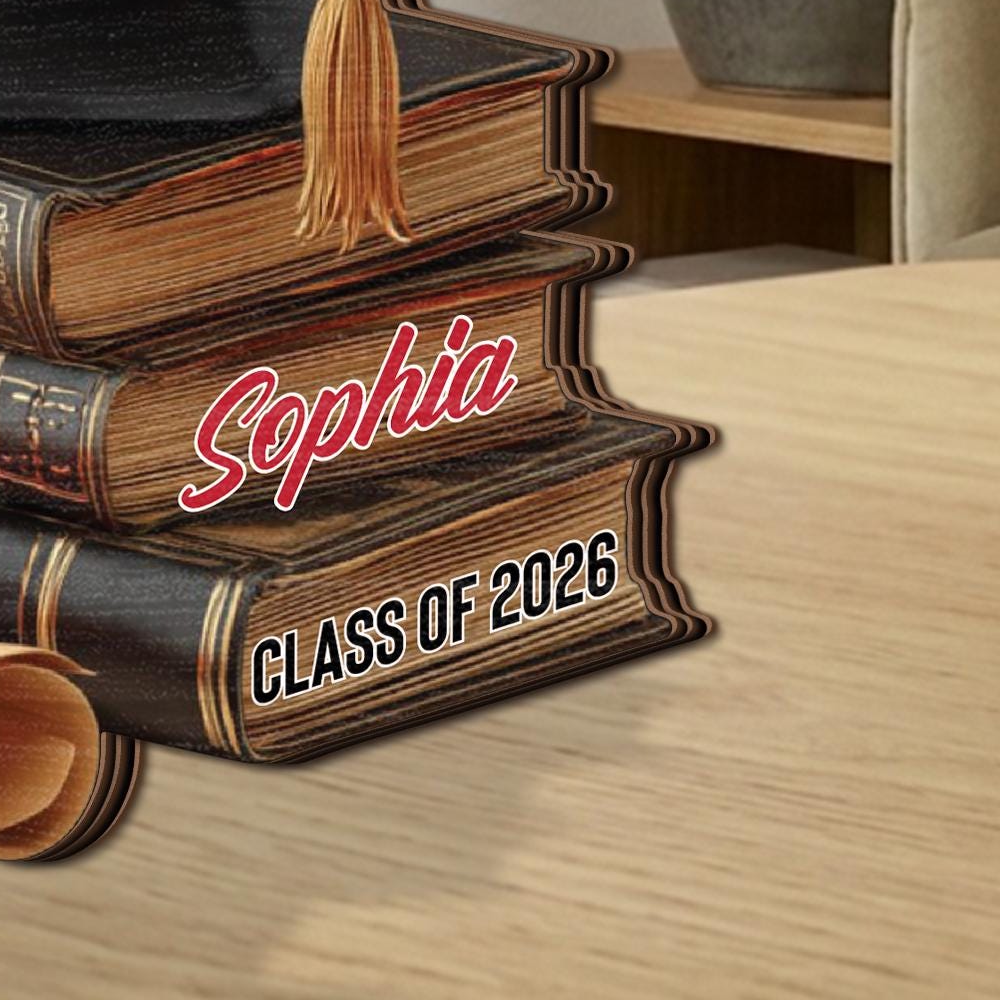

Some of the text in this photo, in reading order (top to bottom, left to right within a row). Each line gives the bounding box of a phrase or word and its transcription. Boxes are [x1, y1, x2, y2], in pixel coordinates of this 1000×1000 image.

[178, 314, 517, 513] Sophia
[251, 529, 618, 706] CLASS OF 2026
